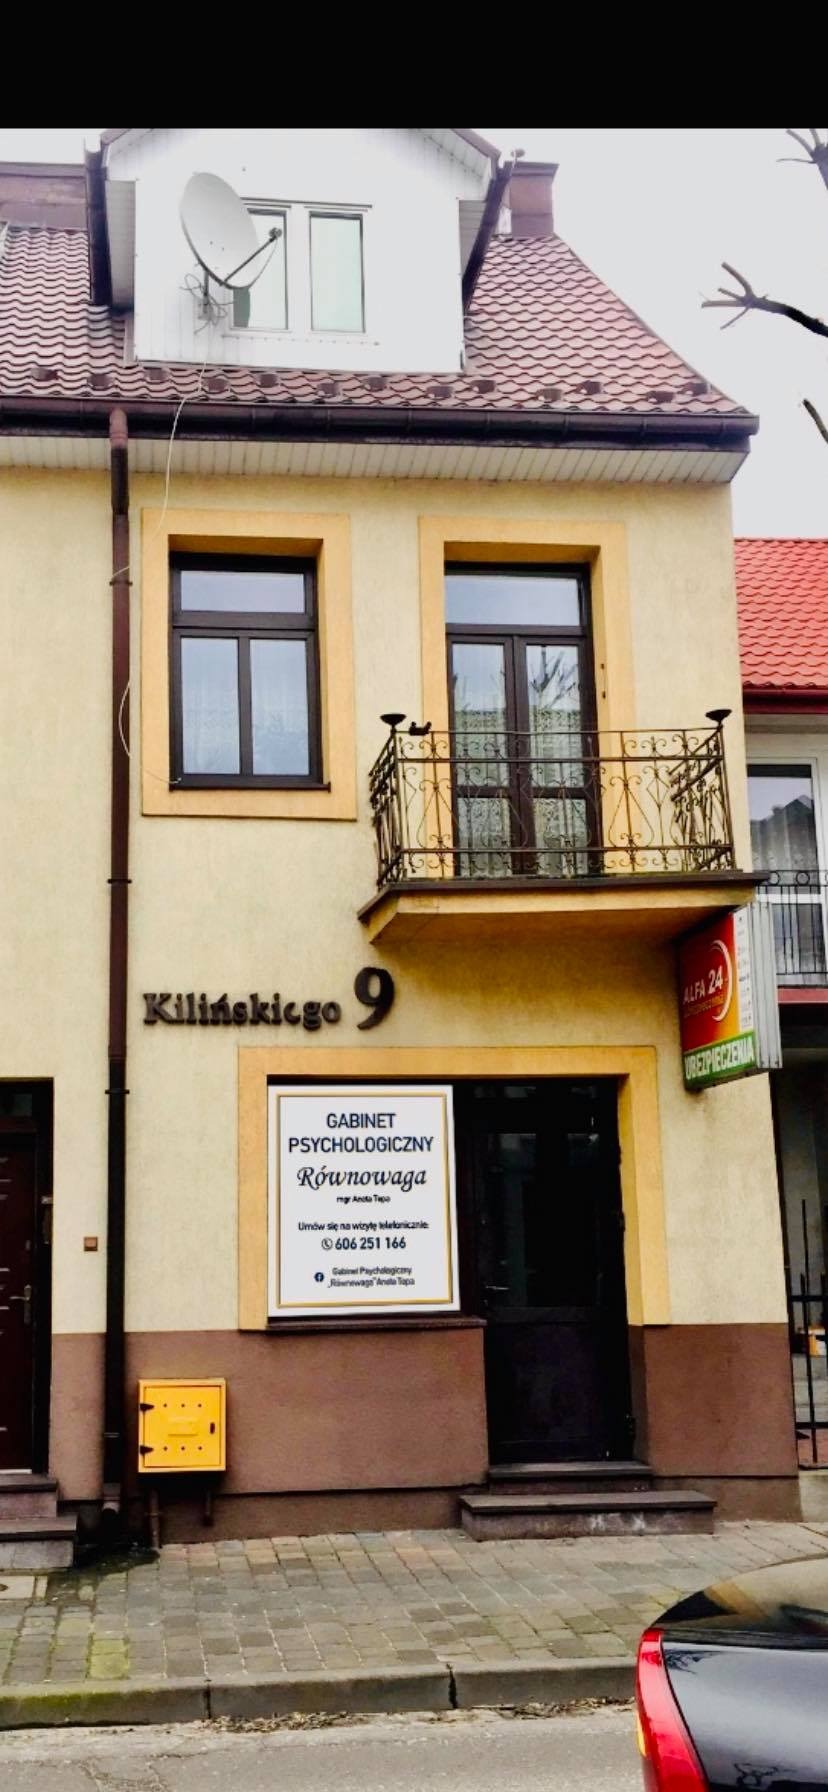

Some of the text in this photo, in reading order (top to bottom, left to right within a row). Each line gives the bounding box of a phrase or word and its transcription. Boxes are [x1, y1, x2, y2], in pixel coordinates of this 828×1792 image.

[683, 965, 723, 1003] ALFA 24
[354, 967, 395, 1030] 9
[685, 1037, 752, 1080] UBEZPIECZENIA
[326, 1113, 396, 1129] GABINET
[288, 1136, 434, 1153] PSYCHOLOGICZNY
[296, 1165, 427, 1192] Równowaga
[336, 1196, 351, 1205] mgr
[298, 1222, 325, 1231] Umów
[327, 1221, 338, 1232] się
[340, 1222, 351, 1231] na
[352, 1221, 377, 1232] wizytę
[335, 1236, 406, 1250] 606 251 166
[332, 1266, 412, 1276] Gabinet Psychologiczny
